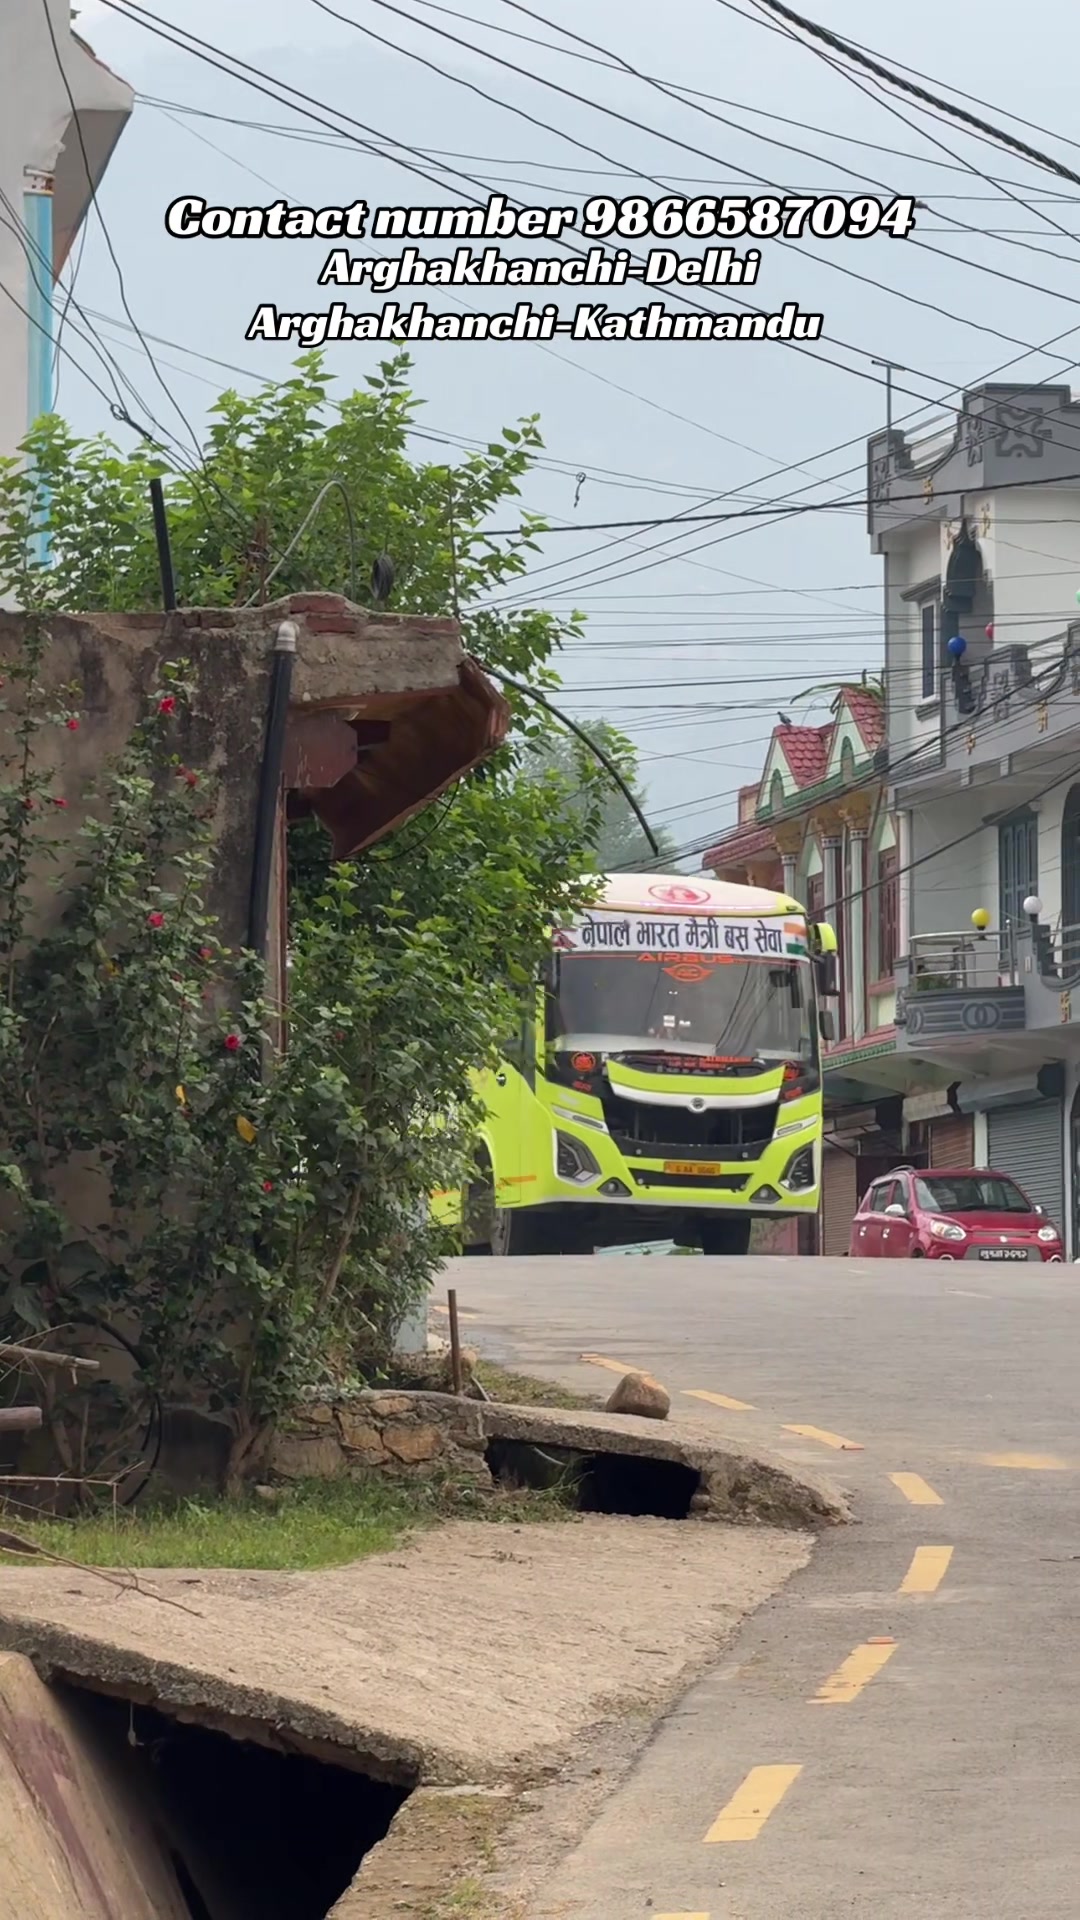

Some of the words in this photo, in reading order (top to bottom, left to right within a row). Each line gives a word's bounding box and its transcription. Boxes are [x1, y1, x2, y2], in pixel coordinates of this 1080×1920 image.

[581, 914, 631, 948] नेपाल
[636, 920, 680, 948] भारत
[685, 917, 719, 949] मैत्री
[724, 924, 749, 951] बस
[754, 920, 784, 954] सेवा
[636, 952, 735, 964] AIRBUS
